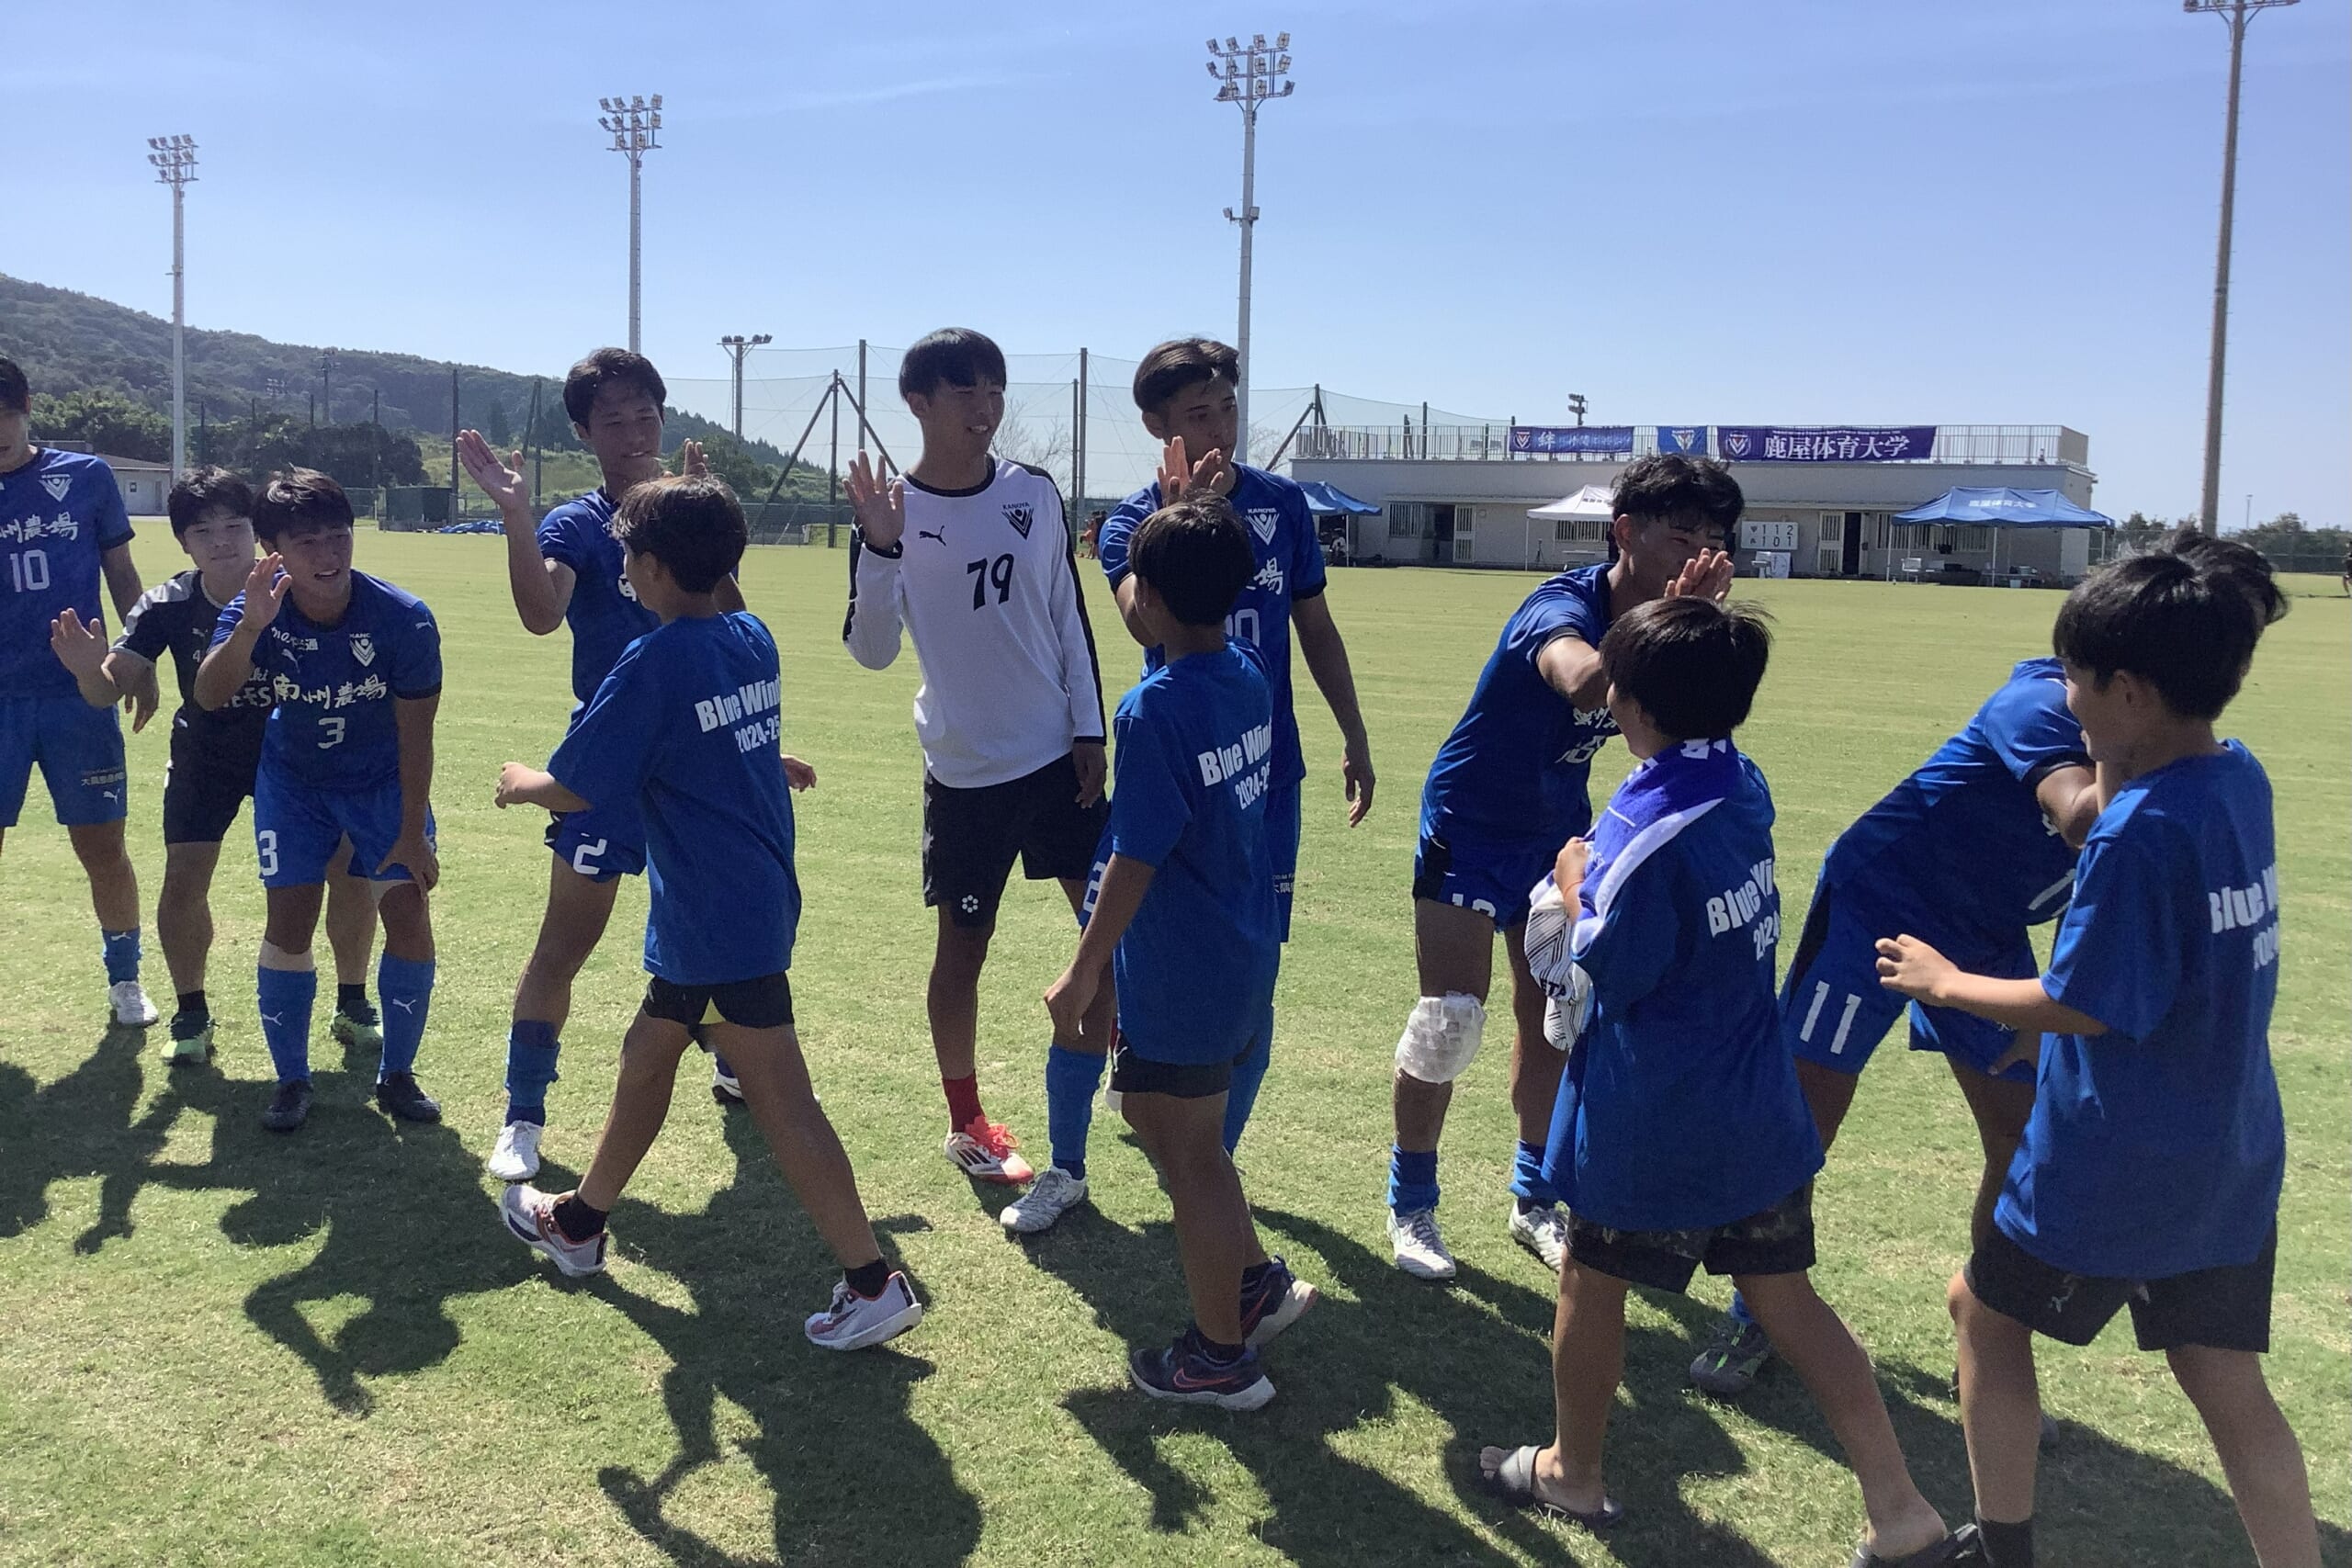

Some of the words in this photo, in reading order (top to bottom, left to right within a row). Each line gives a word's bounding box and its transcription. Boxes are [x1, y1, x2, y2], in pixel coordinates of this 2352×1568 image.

[1763, 434, 1911, 460] 鹿屋体育大学
[9, 549, 51, 593] 10
[966, 553, 1015, 613] 79
[273, 673, 388, 710] 南州農場
[695, 694, 742, 733] Blue
[317, 716, 346, 750] 3
[1197, 743, 1244, 787] Blue
[259, 829, 279, 876] 3
[1705, 880, 1761, 939] Blue
[2208, 882, 2266, 934] Blue
[1799, 979, 1863, 1056] 11
